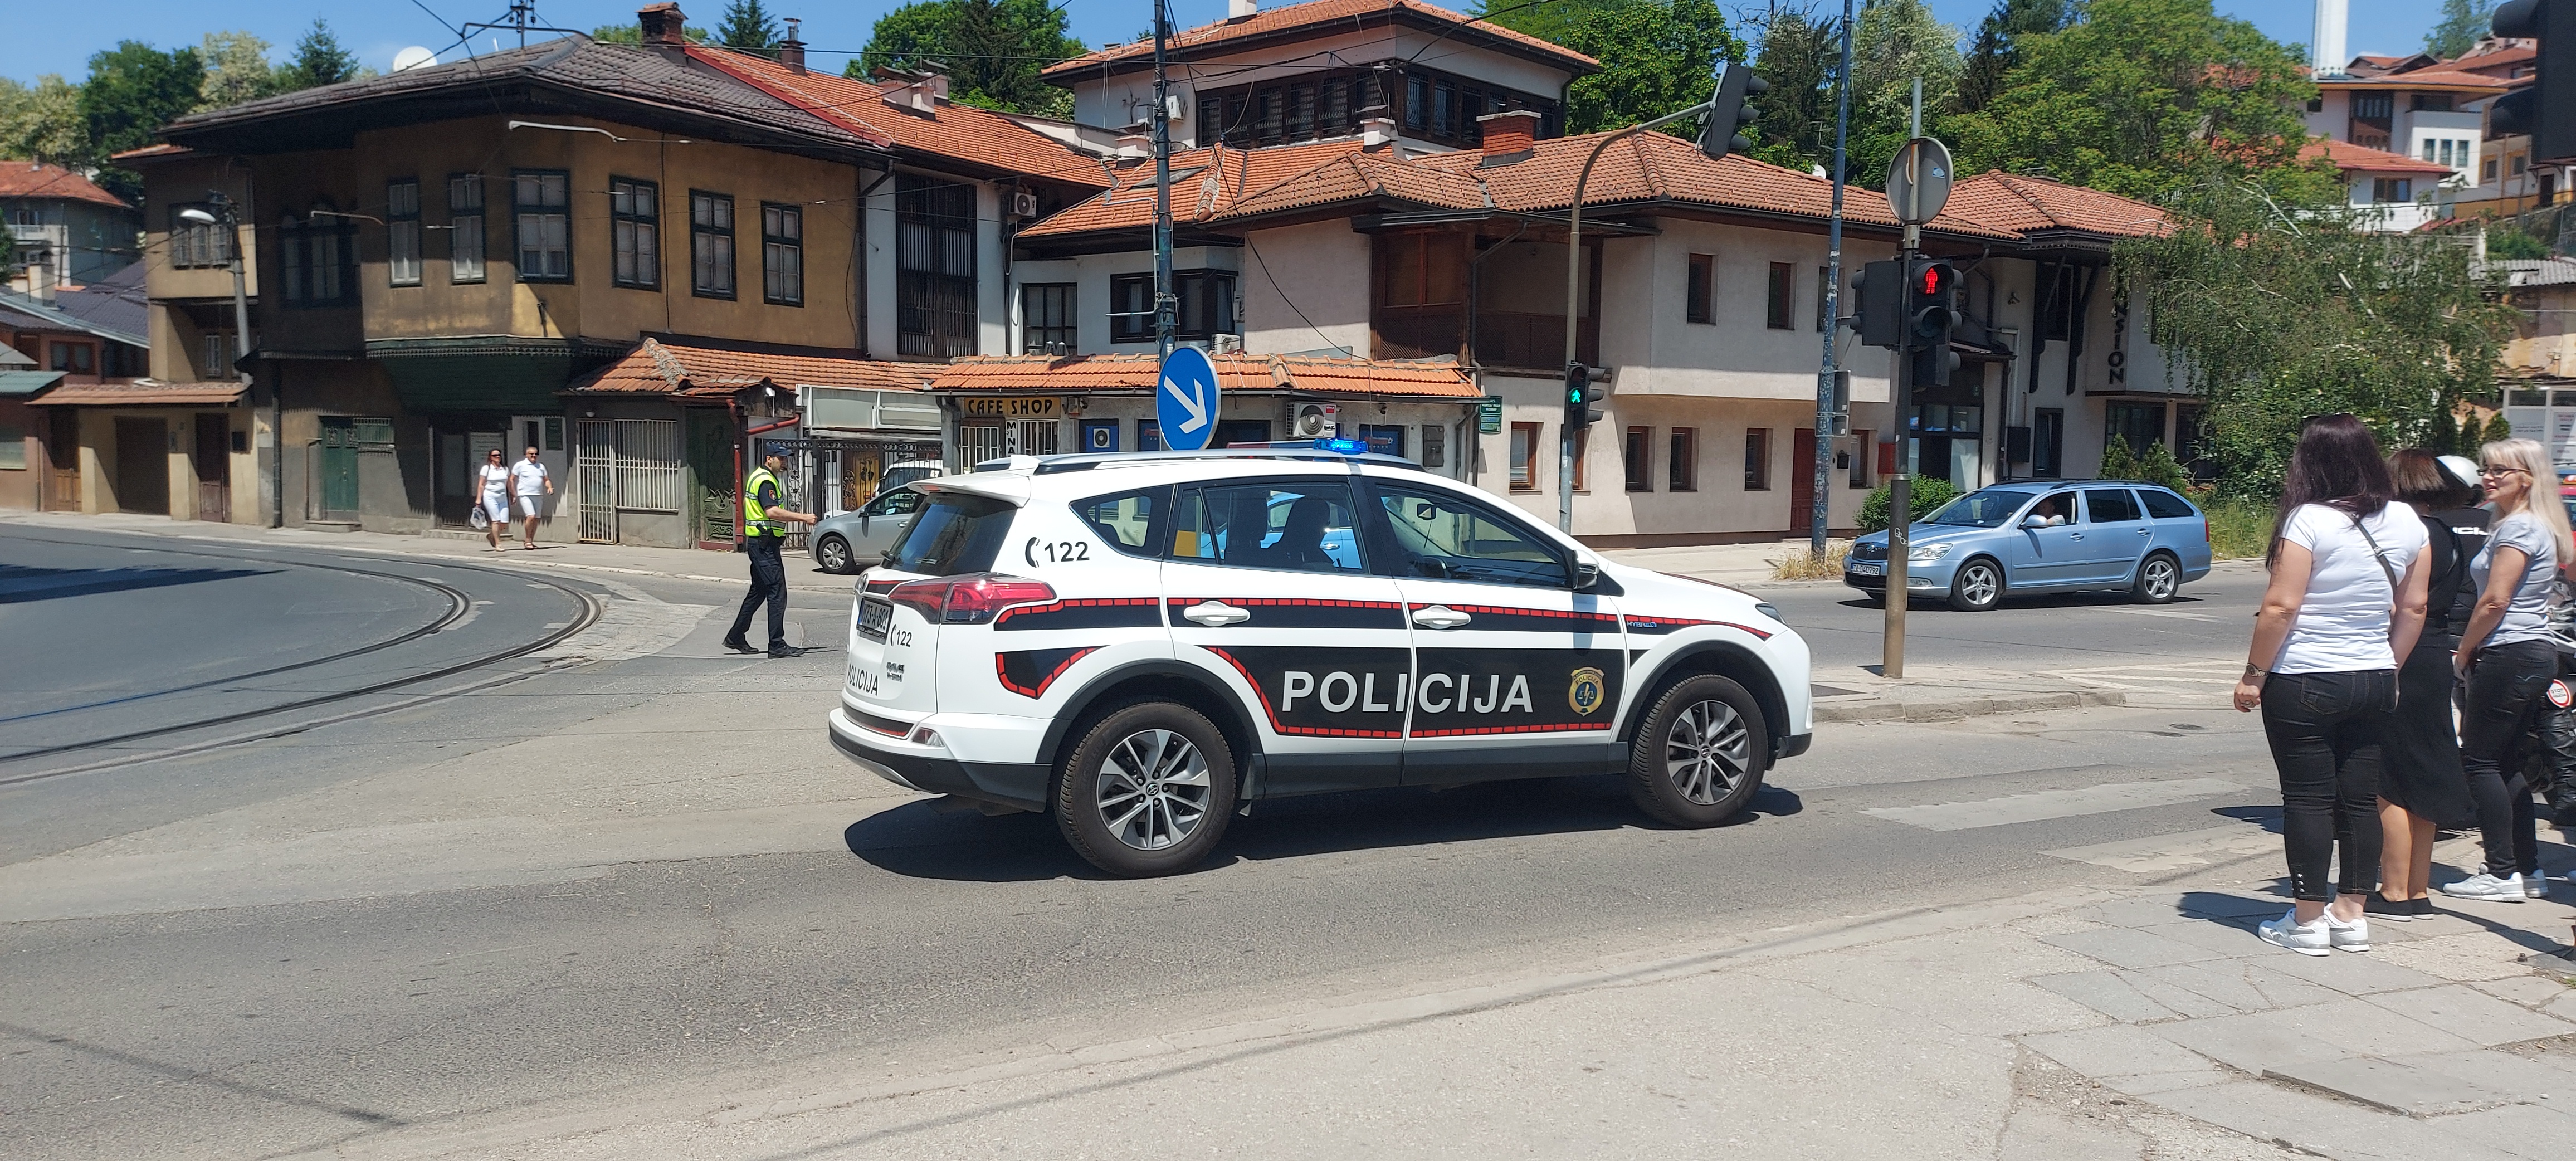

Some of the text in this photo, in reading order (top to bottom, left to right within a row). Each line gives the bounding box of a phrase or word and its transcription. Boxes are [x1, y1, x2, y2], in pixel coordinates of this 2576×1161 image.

[968, 399, 1053, 415] CAFE SHOP
[1007, 422, 1016, 454] MINA
[1044, 541, 1090, 563] 122
[896, 631, 913, 647] 122
[846, 663, 879, 696] POLICIJA
[1575, 675, 1598, 685] POLICIJA
[1282, 671, 1533, 713] POLICIJA
